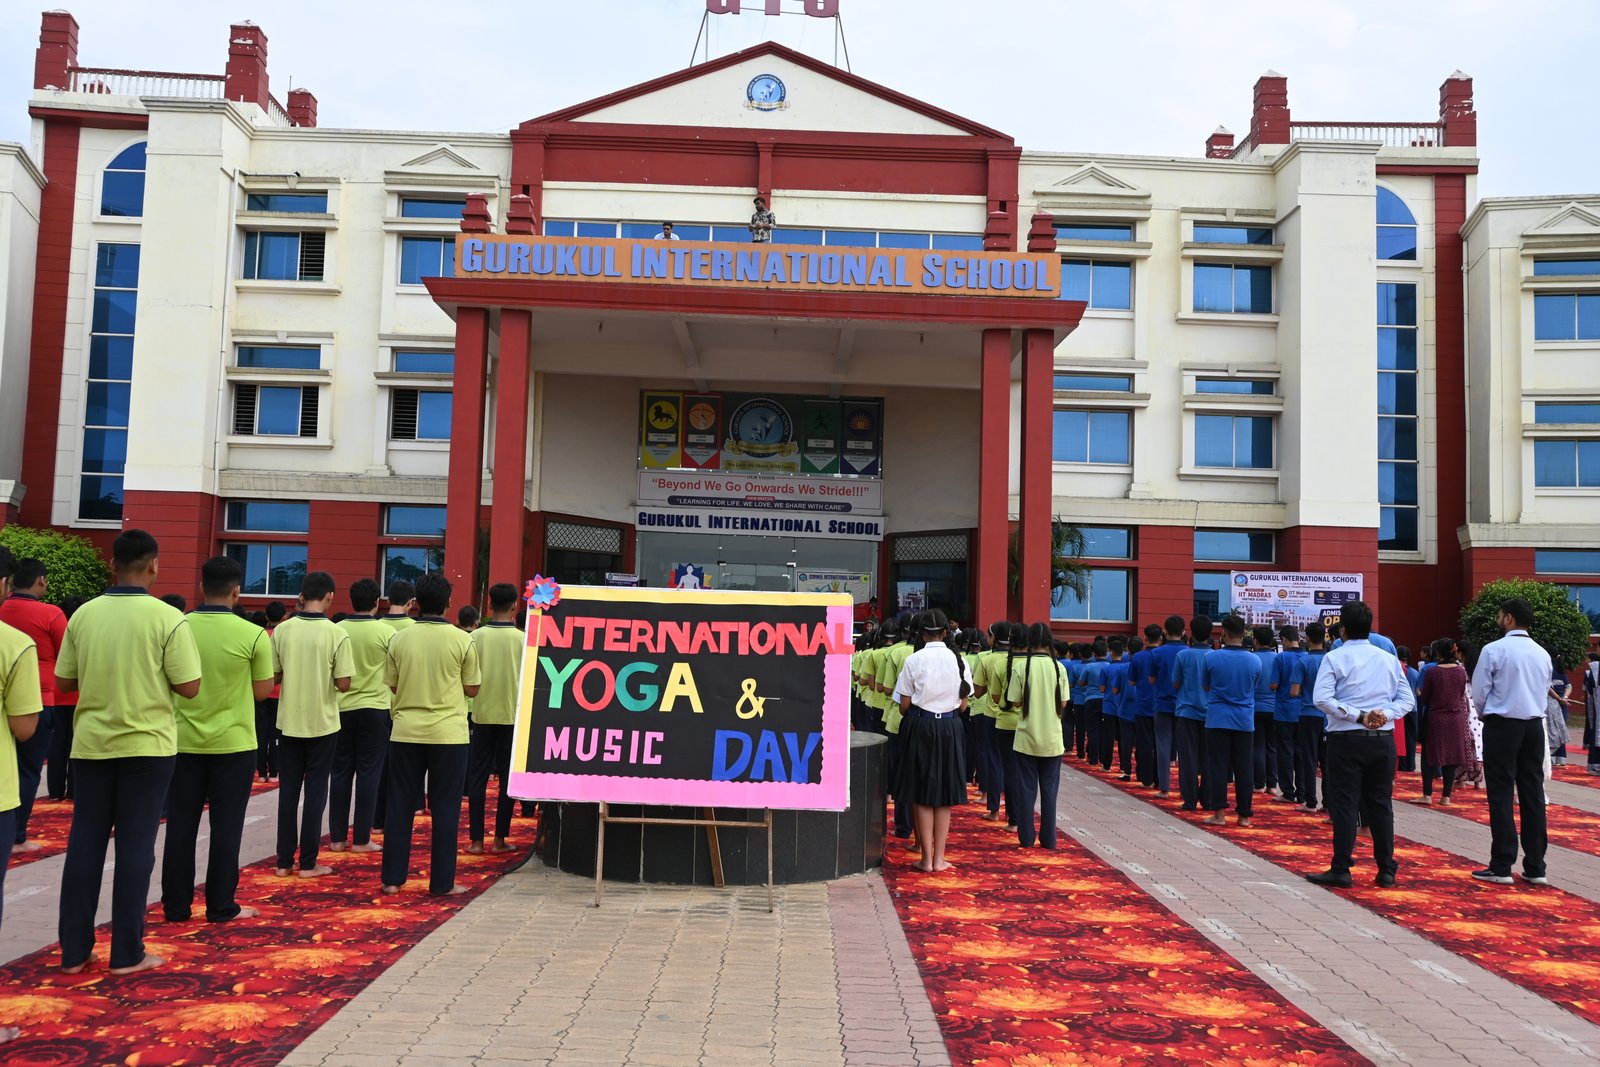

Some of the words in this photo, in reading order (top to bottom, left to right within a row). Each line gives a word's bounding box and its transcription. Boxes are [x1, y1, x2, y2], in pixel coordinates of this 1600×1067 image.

[462, 238, 622, 277] GURUKUL
[631, 243, 913, 286] INTERNATIONAL
[922, 253, 1053, 291] SCHOOL
[704, 480, 722, 491] We
[725, 481, 742, 492] Go
[745, 482, 795, 494] Onwards
[798, 484, 815, 495] We
[638, 512, 702, 529] GURUKUL
[708, 514, 822, 533] INTERNATIONAL
[829, 519, 881, 536] SCHOOL
[1250, 574, 1280, 582] GURUKUL
[1281, 575, 1330, 583] INTERNATIONAL
[527, 614, 855, 655] INTERNATIONAL
[1323, 616, 1341, 627] OP
[538, 656, 704, 713] YOGA
[735, 678, 766, 719] &
[544, 726, 664, 764] MUSIC
[711, 729, 822, 784] DAY
